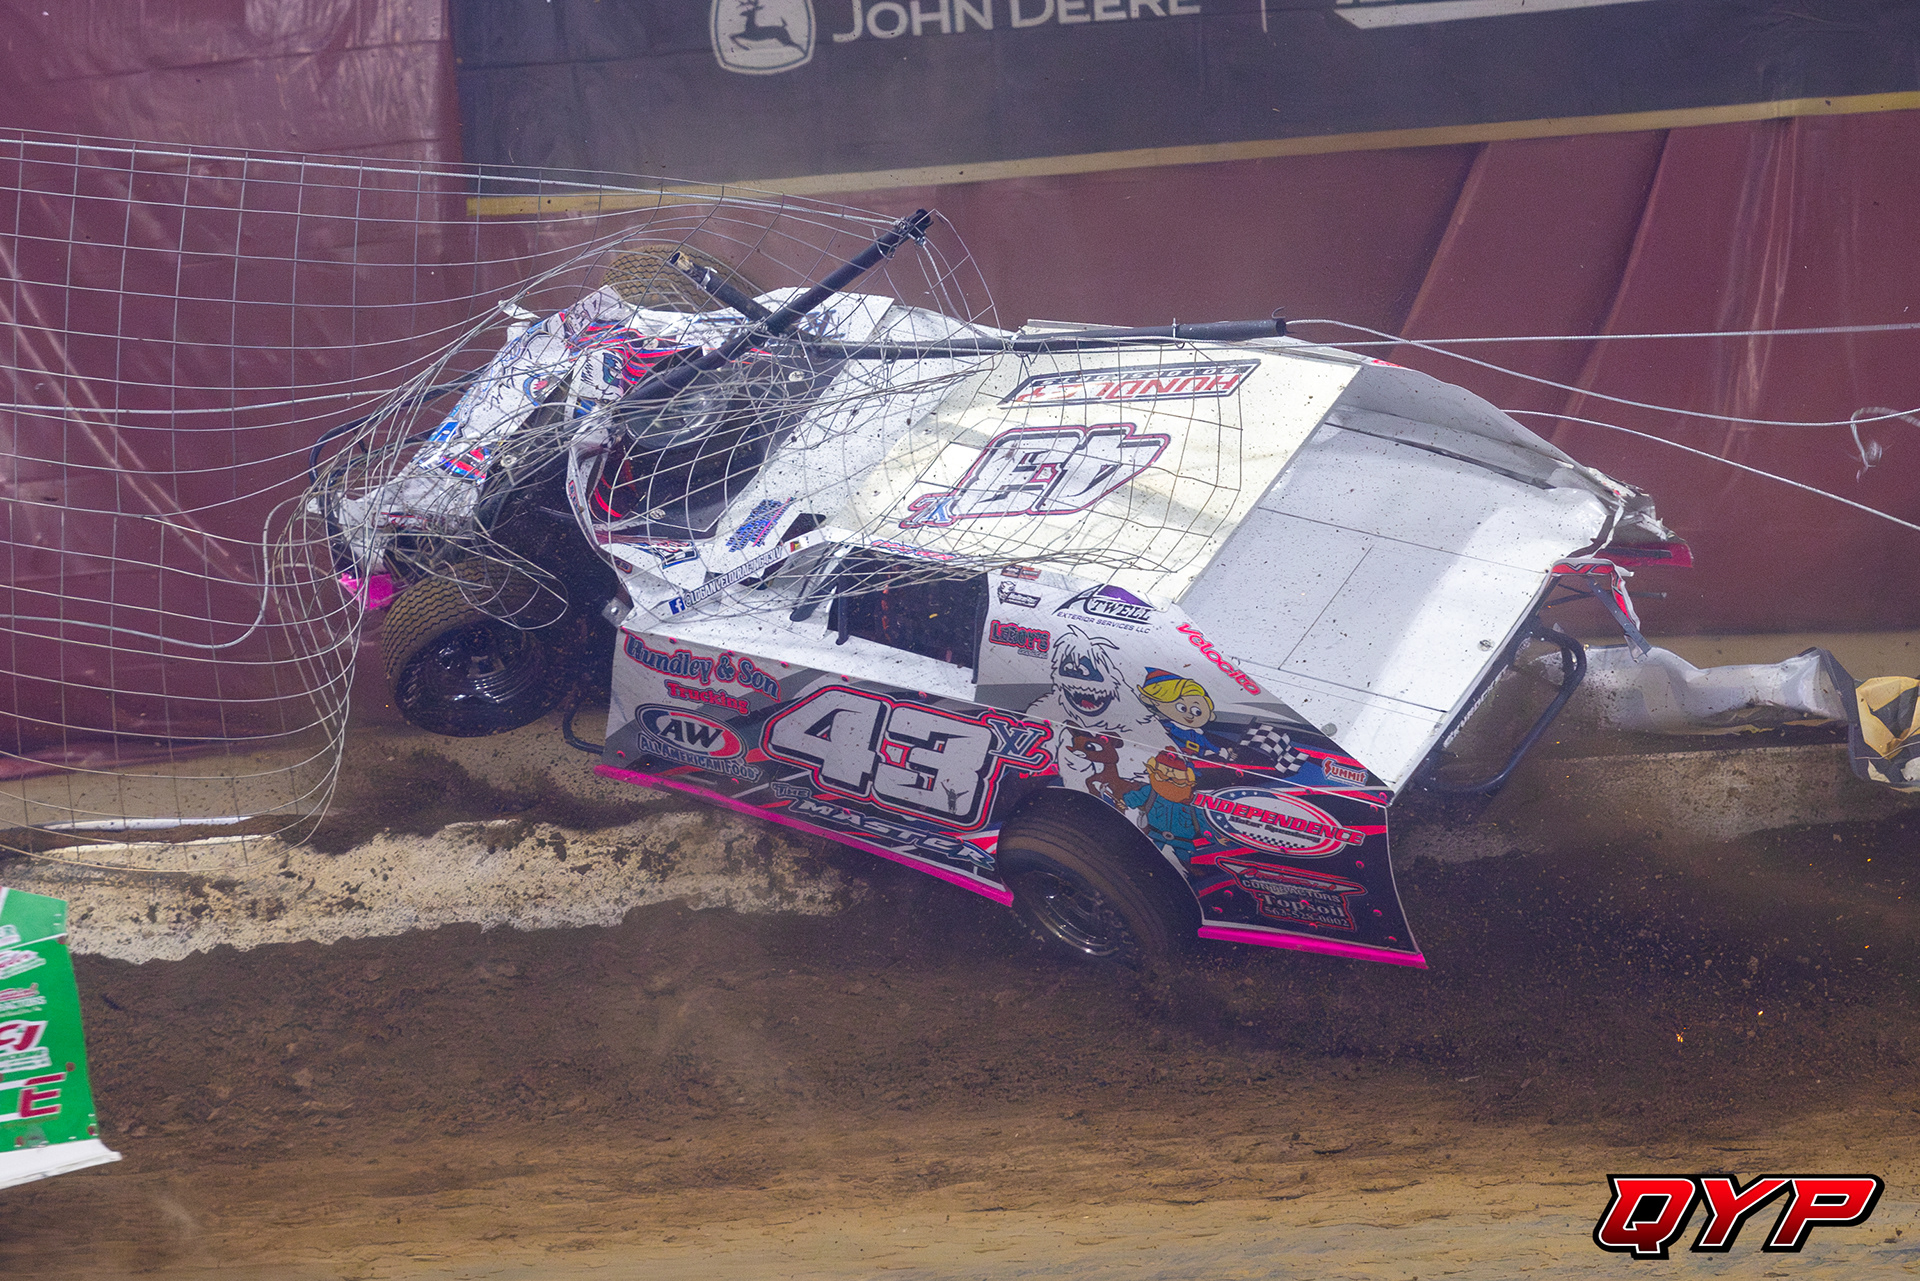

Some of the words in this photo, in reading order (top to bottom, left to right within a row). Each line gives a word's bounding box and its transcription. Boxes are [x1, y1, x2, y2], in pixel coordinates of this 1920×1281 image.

[832, 0, 994, 42] JOHN
[1052, 583, 1152, 622] ATWELL
[1057, 611, 1095, 623] EXTERIOR
[1096, 618, 1134, 631] SERVICES
[1136, 626, 1151, 634] LLC
[625, 633, 713, 685] Hundley
[715, 654, 736, 682] &
[738, 658, 780, 701] Son
[666, 681, 750, 715] Trucking
[662, 743, 722, 773] AMERICAN
[723, 761, 759, 780] FOOD
[764, 686, 995, 829] 43
[773, 784, 811, 798] THE
[797, 799, 992, 867] MASTER
[1192, 792, 1365, 846] INDEPENDENCE
[1258, 894, 1346, 917] Topsoil
